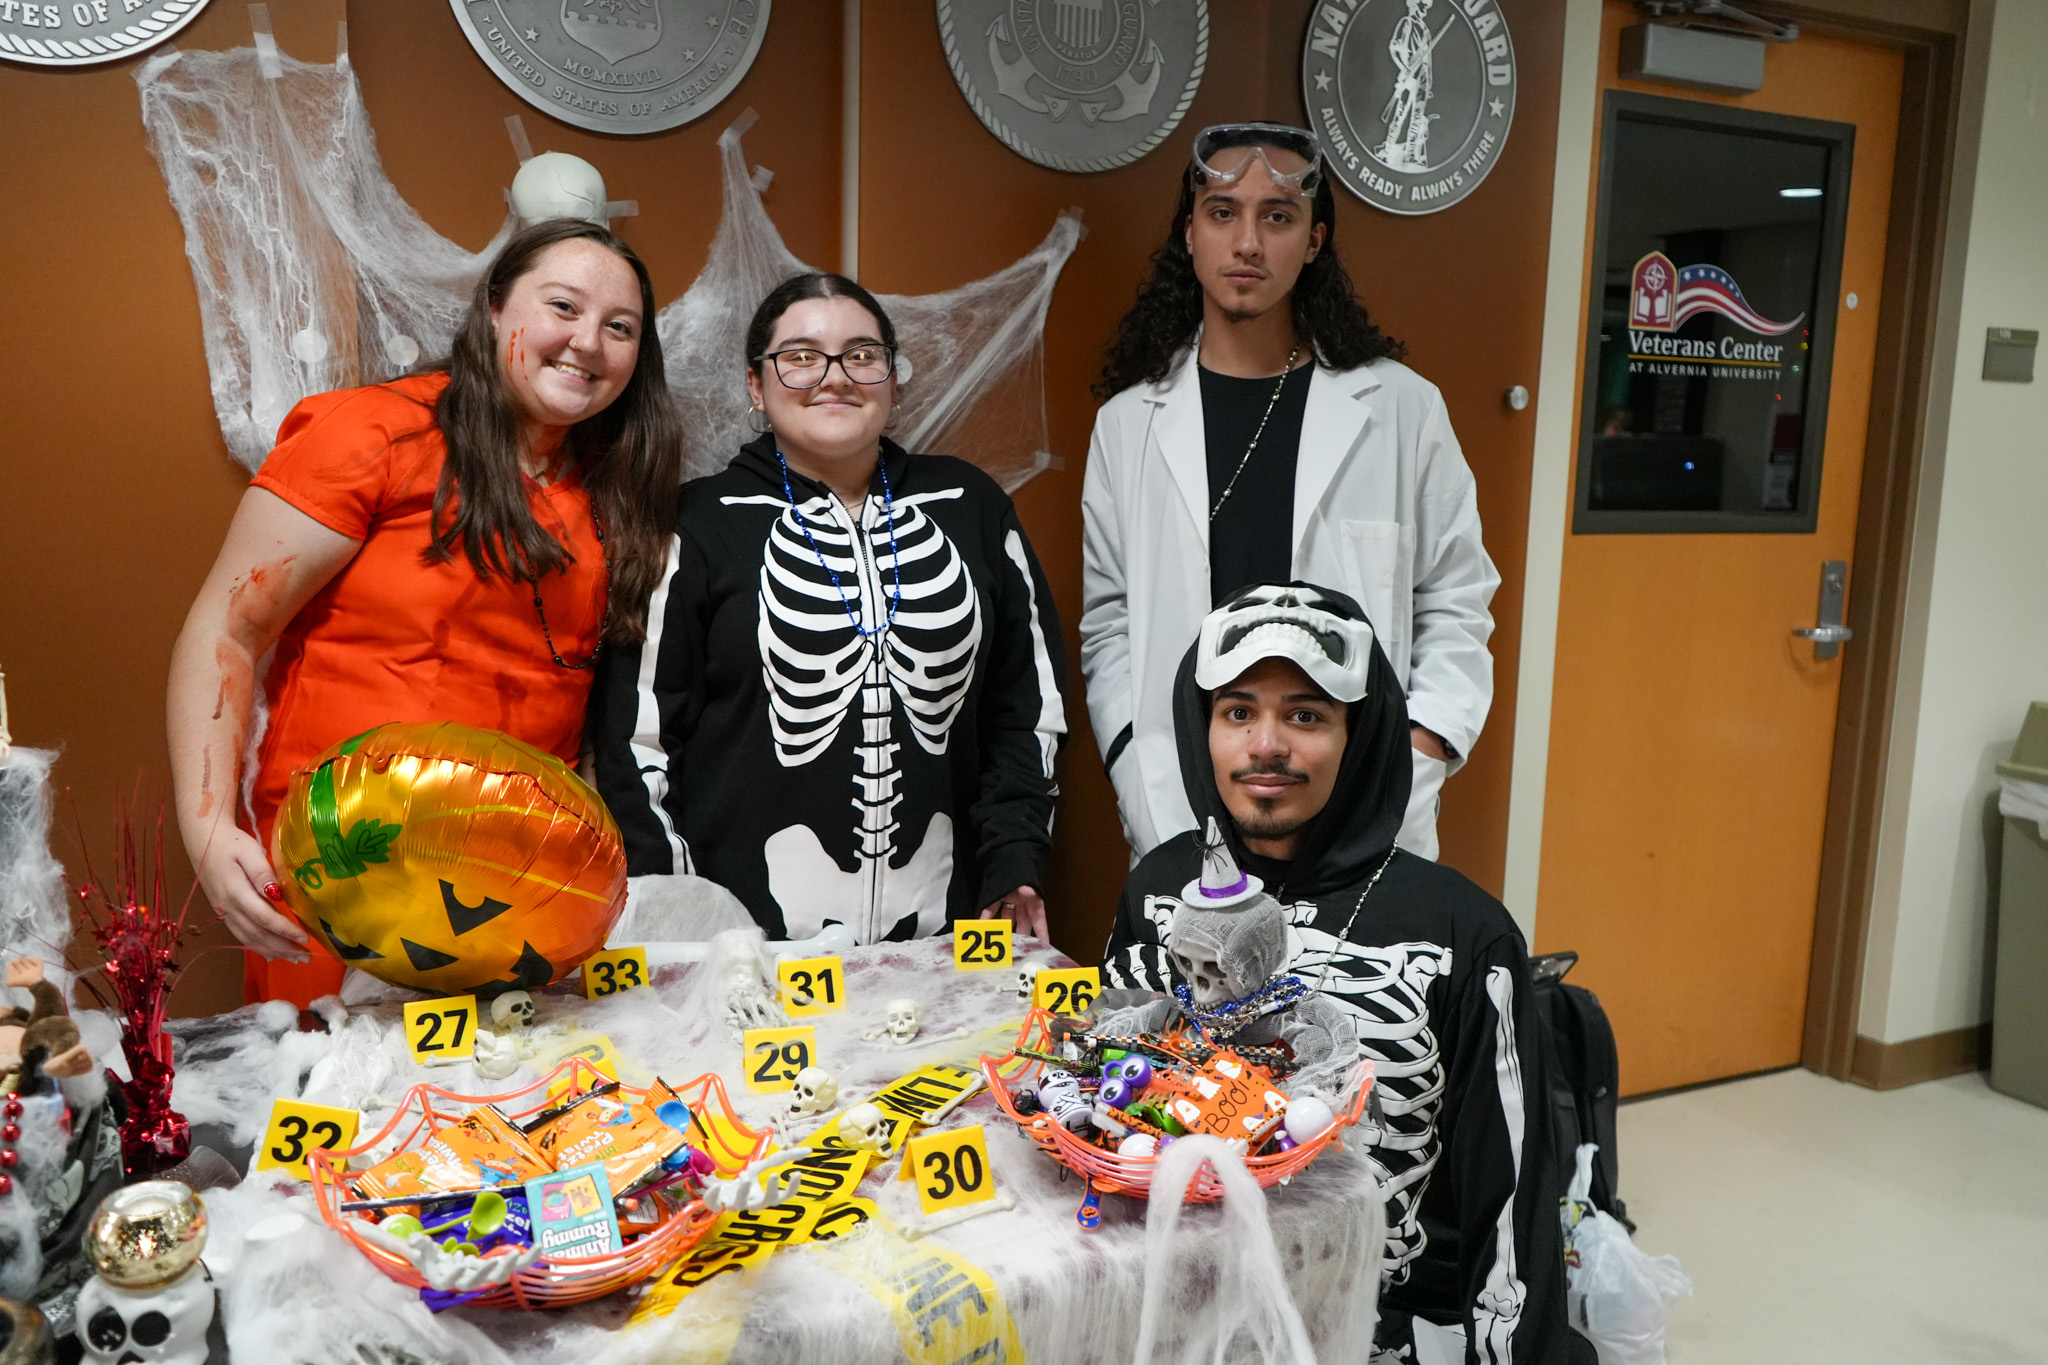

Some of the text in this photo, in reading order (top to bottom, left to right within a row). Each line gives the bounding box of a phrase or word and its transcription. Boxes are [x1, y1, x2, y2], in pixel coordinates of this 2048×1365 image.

[72, 0, 109, 27] OF
[1112, 3, 1137, 66] GUARD
[487, 27, 728, 116] UNITED STATES OF AMERICA
[564, 57, 662, 86] MCMXLVII
[1054, 65, 1097, 85] 1790
[1321, 107, 1496, 201] ALWAYS READY ALWAYS THERE
[1628, 331, 1784, 362] Veterans Center
[1629, 362, 1783, 381] AT ALVERNIA UNIVERSITY
[960, 930, 1006, 963] 25
[592, 958, 642, 996] 33
[789, 968, 836, 1007] 31
[1045, 979, 1094, 1016] 26
[416, 1008, 468, 1053] 27
[753, 1040, 809, 1083] 29
[271, 1115, 342, 1168] 32
[558, 1131, 615, 1171] Pretze
[923, 1144, 983, 1200] 30
[541, 1219, 612, 1249] Rummy
